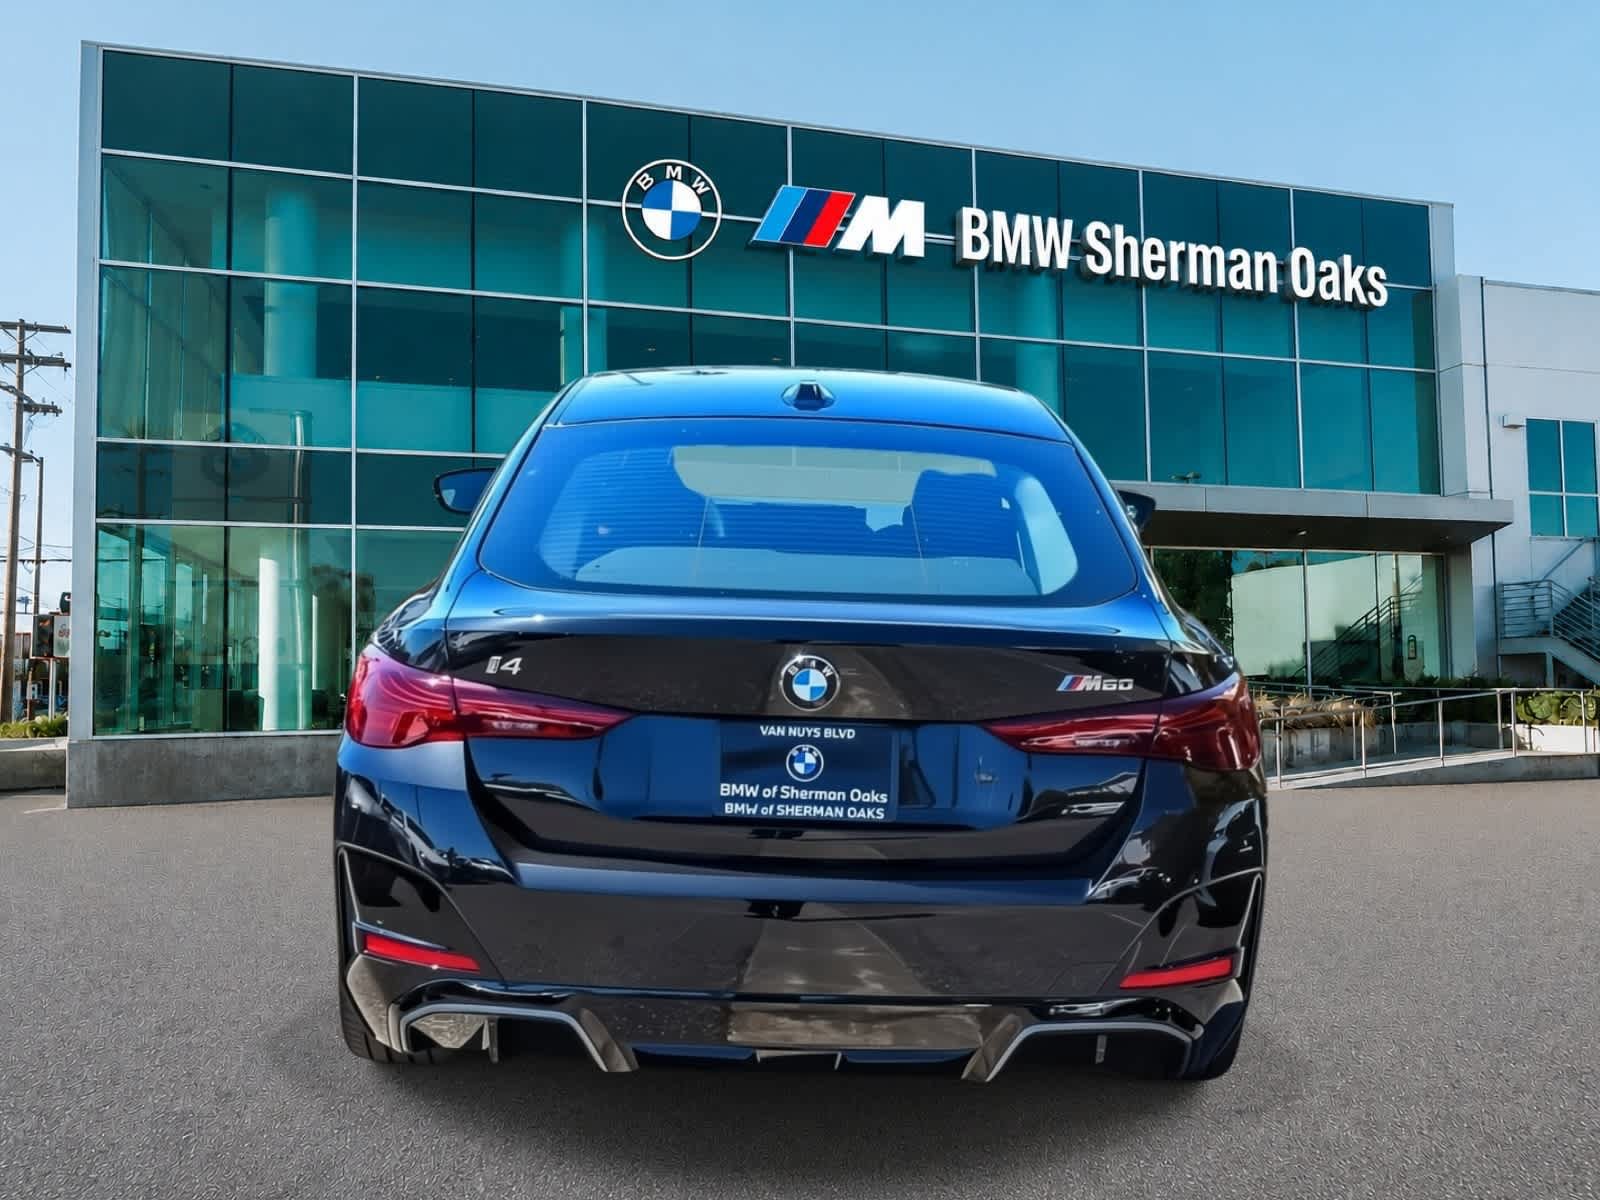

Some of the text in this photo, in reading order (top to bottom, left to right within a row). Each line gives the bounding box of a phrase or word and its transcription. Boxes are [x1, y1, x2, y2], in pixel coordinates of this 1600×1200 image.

[637, 165, 711, 195] BMW
[958, 206, 1388, 308] BMW Sherman Oaks
[759, 725, 856, 739] VAN NUYS BLVD
[719, 783, 888, 804] BMW of Sherman Oaks
[724, 803, 885, 819] BMW of SHERMAN OAKS
